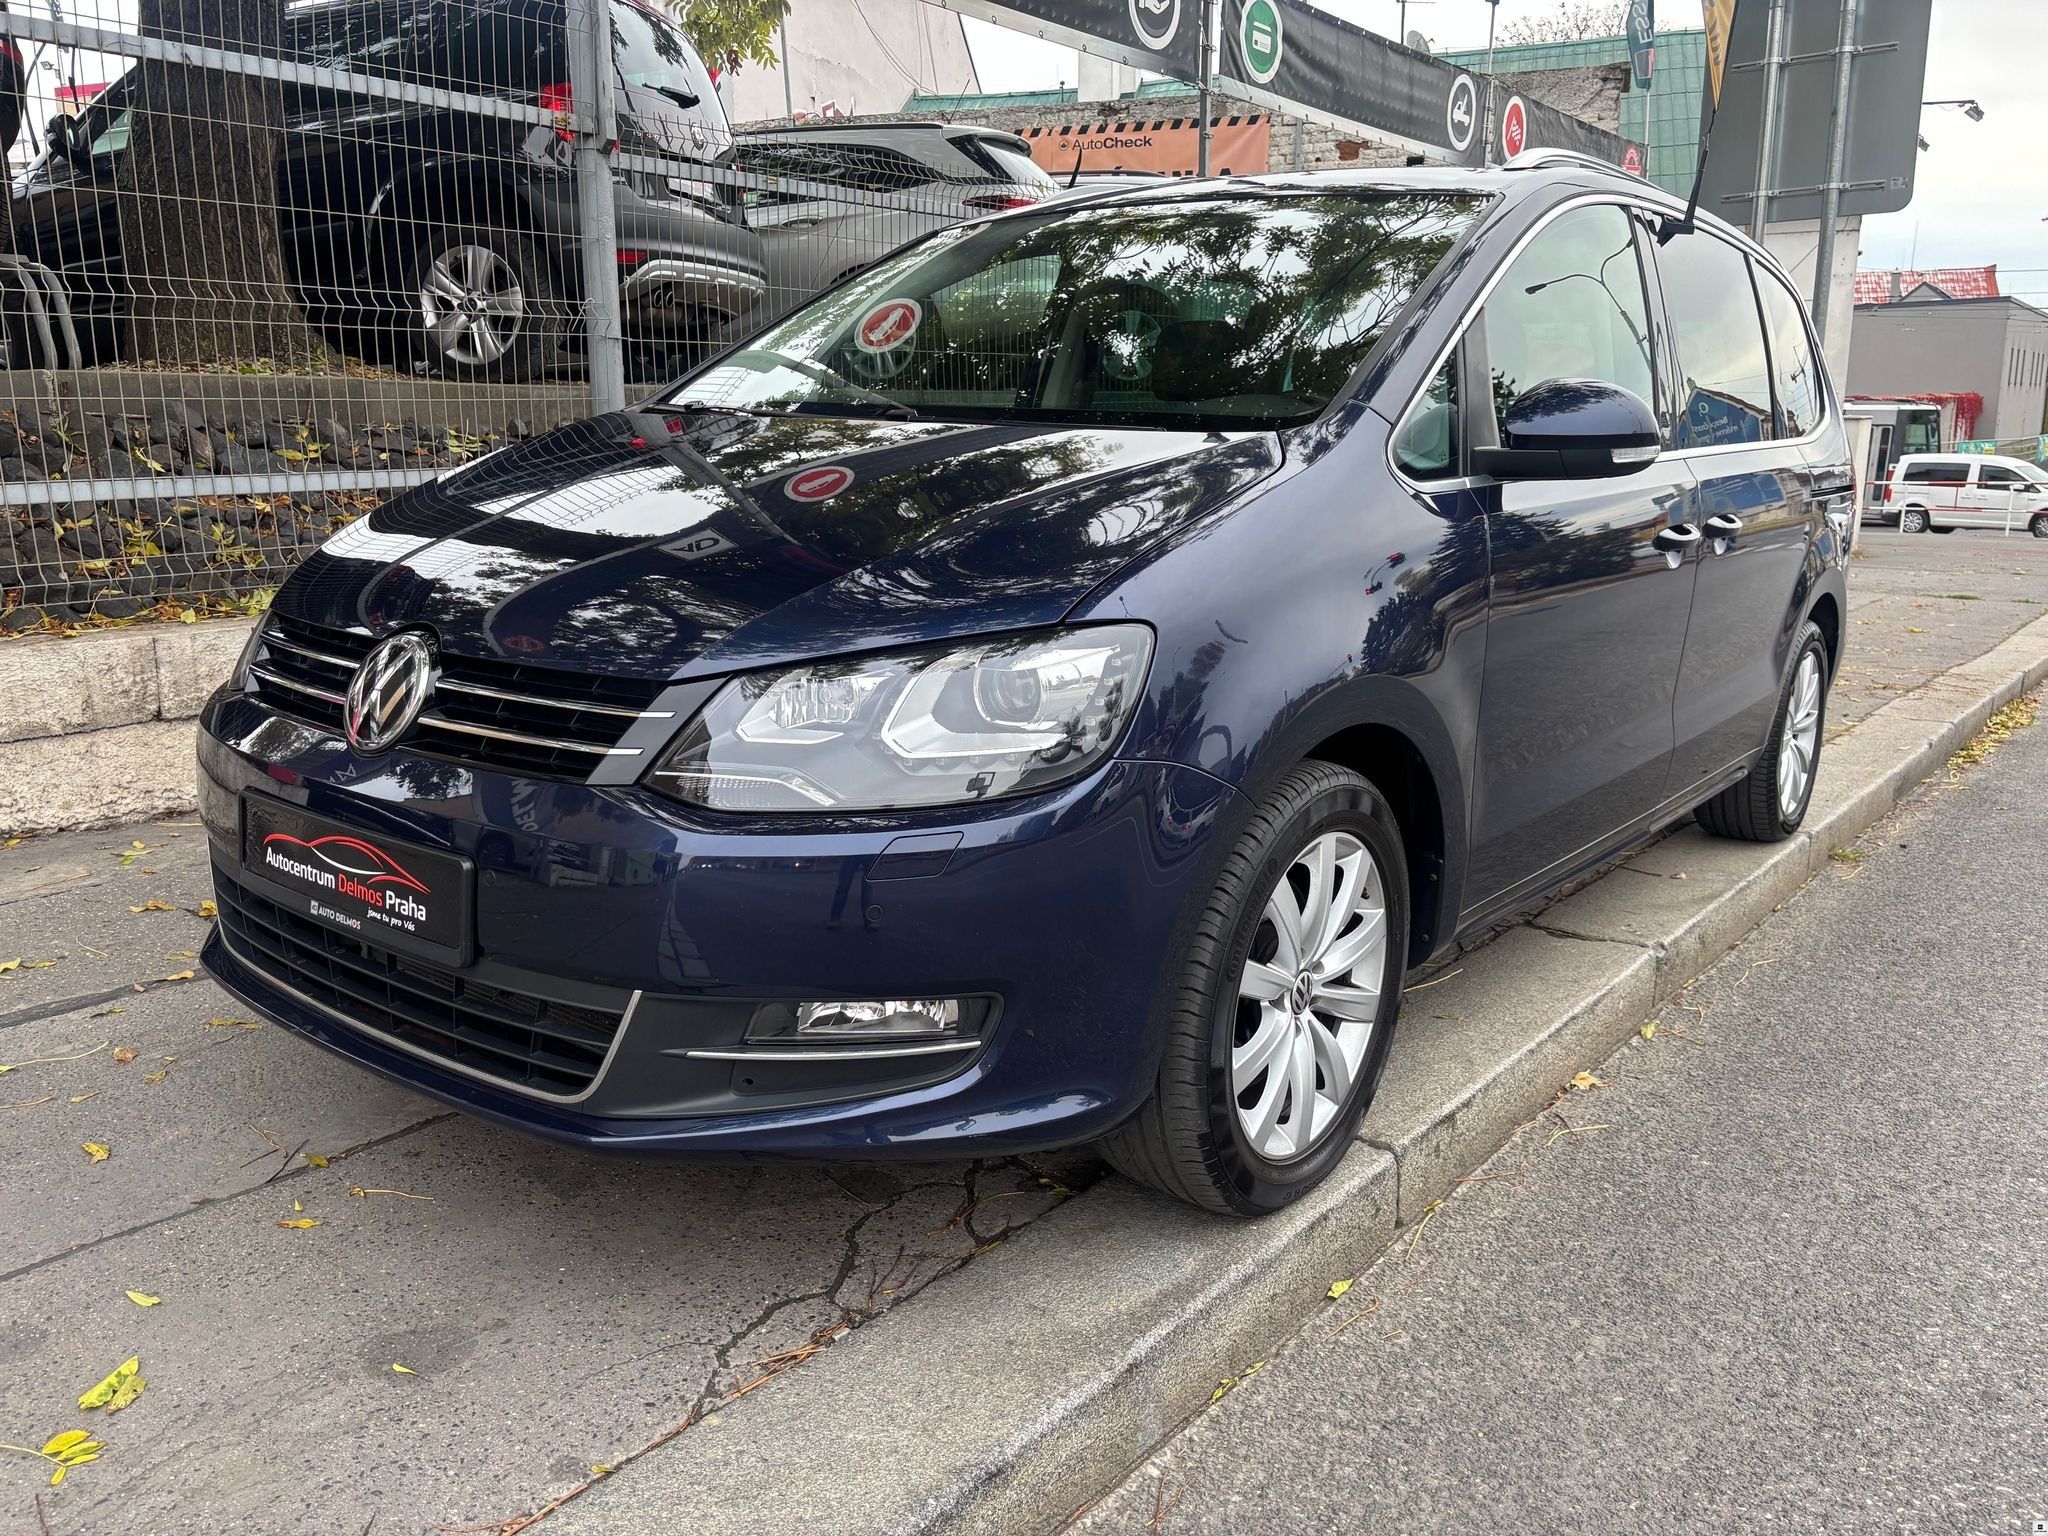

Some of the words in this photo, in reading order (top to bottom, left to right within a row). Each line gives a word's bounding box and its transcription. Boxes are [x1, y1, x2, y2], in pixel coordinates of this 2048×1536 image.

[1072, 135, 1153, 151] AutoCheck
[265, 846, 336, 889] Autocentrum
[338, 872, 383, 908] Delmos
[385, 889, 427, 921] Praha
[318, 905, 335, 920] AUTO
[335, 911, 361, 930] DELMOS
[382, 912, 390, 923] tu
[390, 916, 403, 927] pro
[403, 920, 416, 932] Vás
